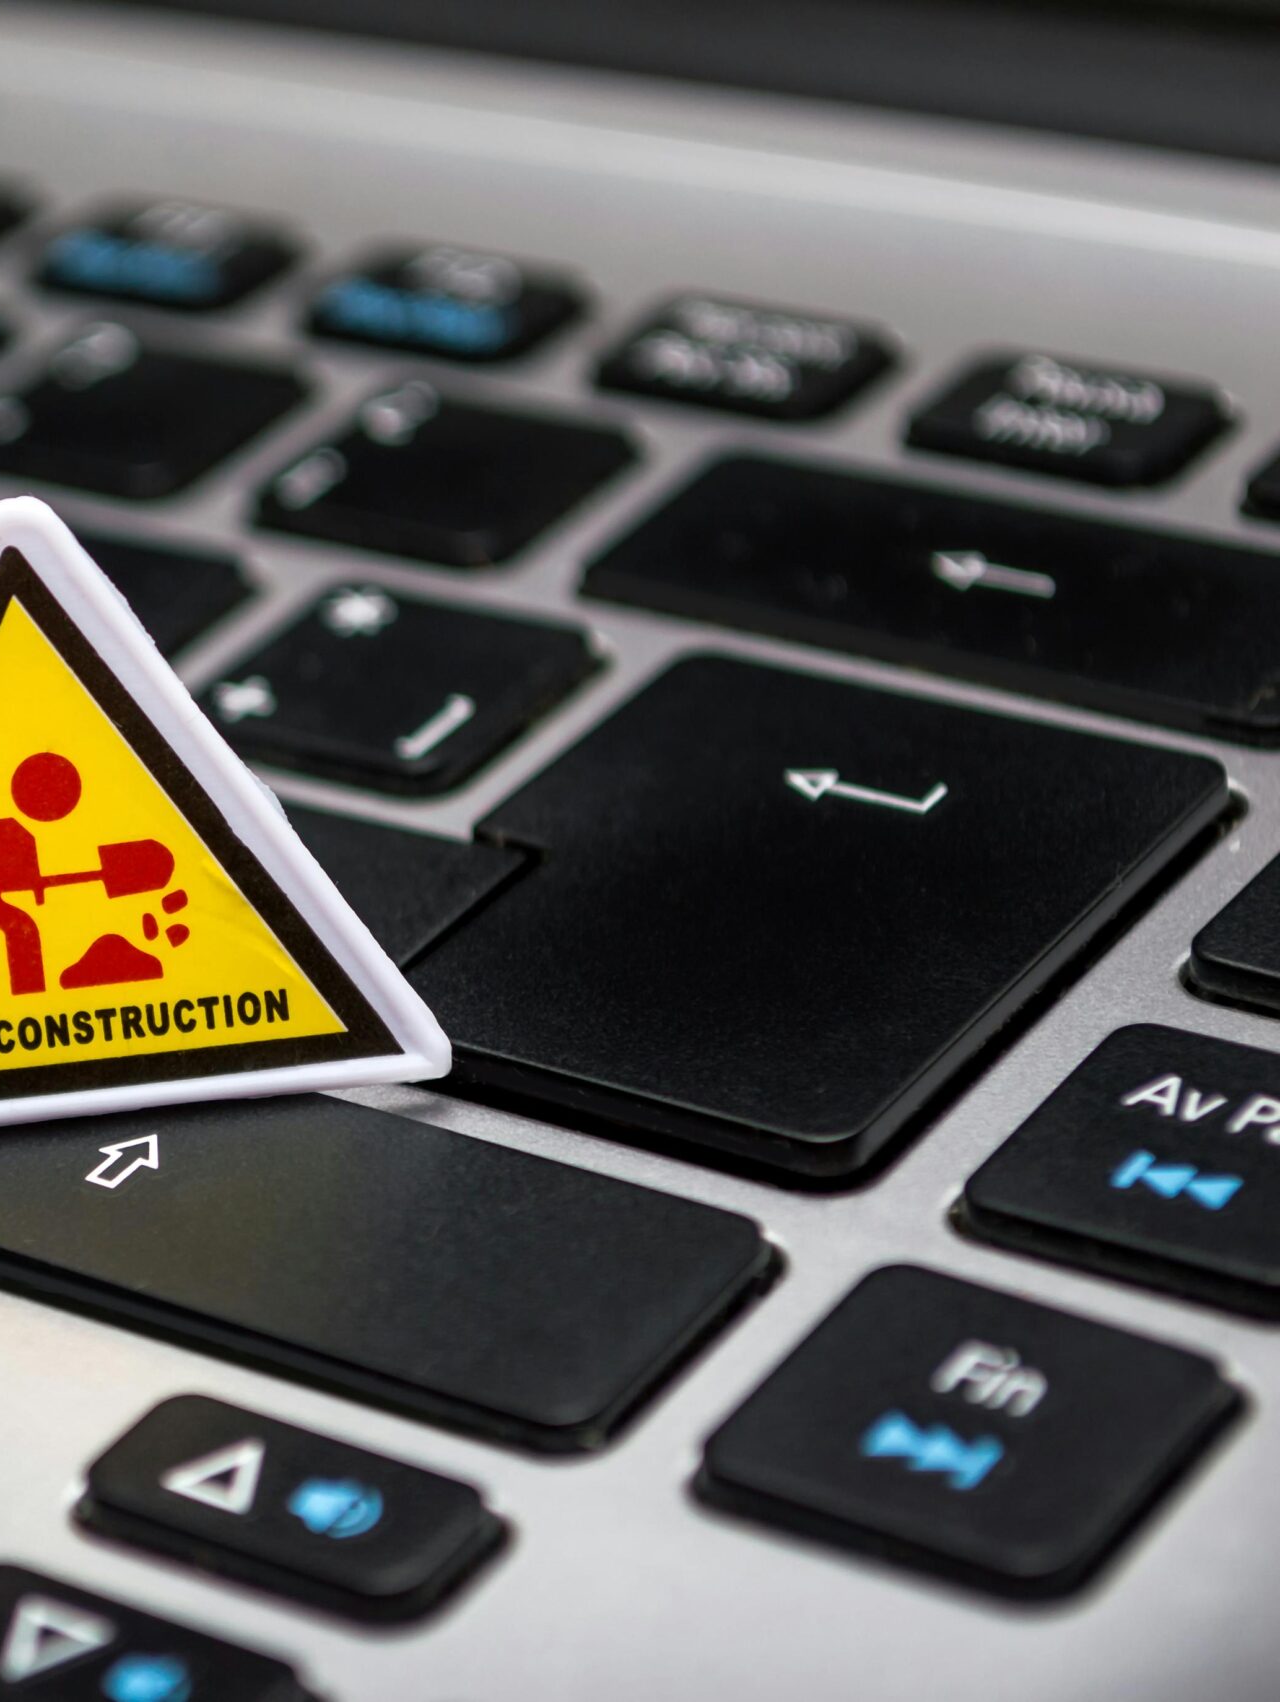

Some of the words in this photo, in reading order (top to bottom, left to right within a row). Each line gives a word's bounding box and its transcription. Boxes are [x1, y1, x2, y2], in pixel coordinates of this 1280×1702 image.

[1122, 1074, 1228, 1122] Av
[1226, 1095, 1280, 1145] P
[930, 1339, 1048, 1418] Fin
